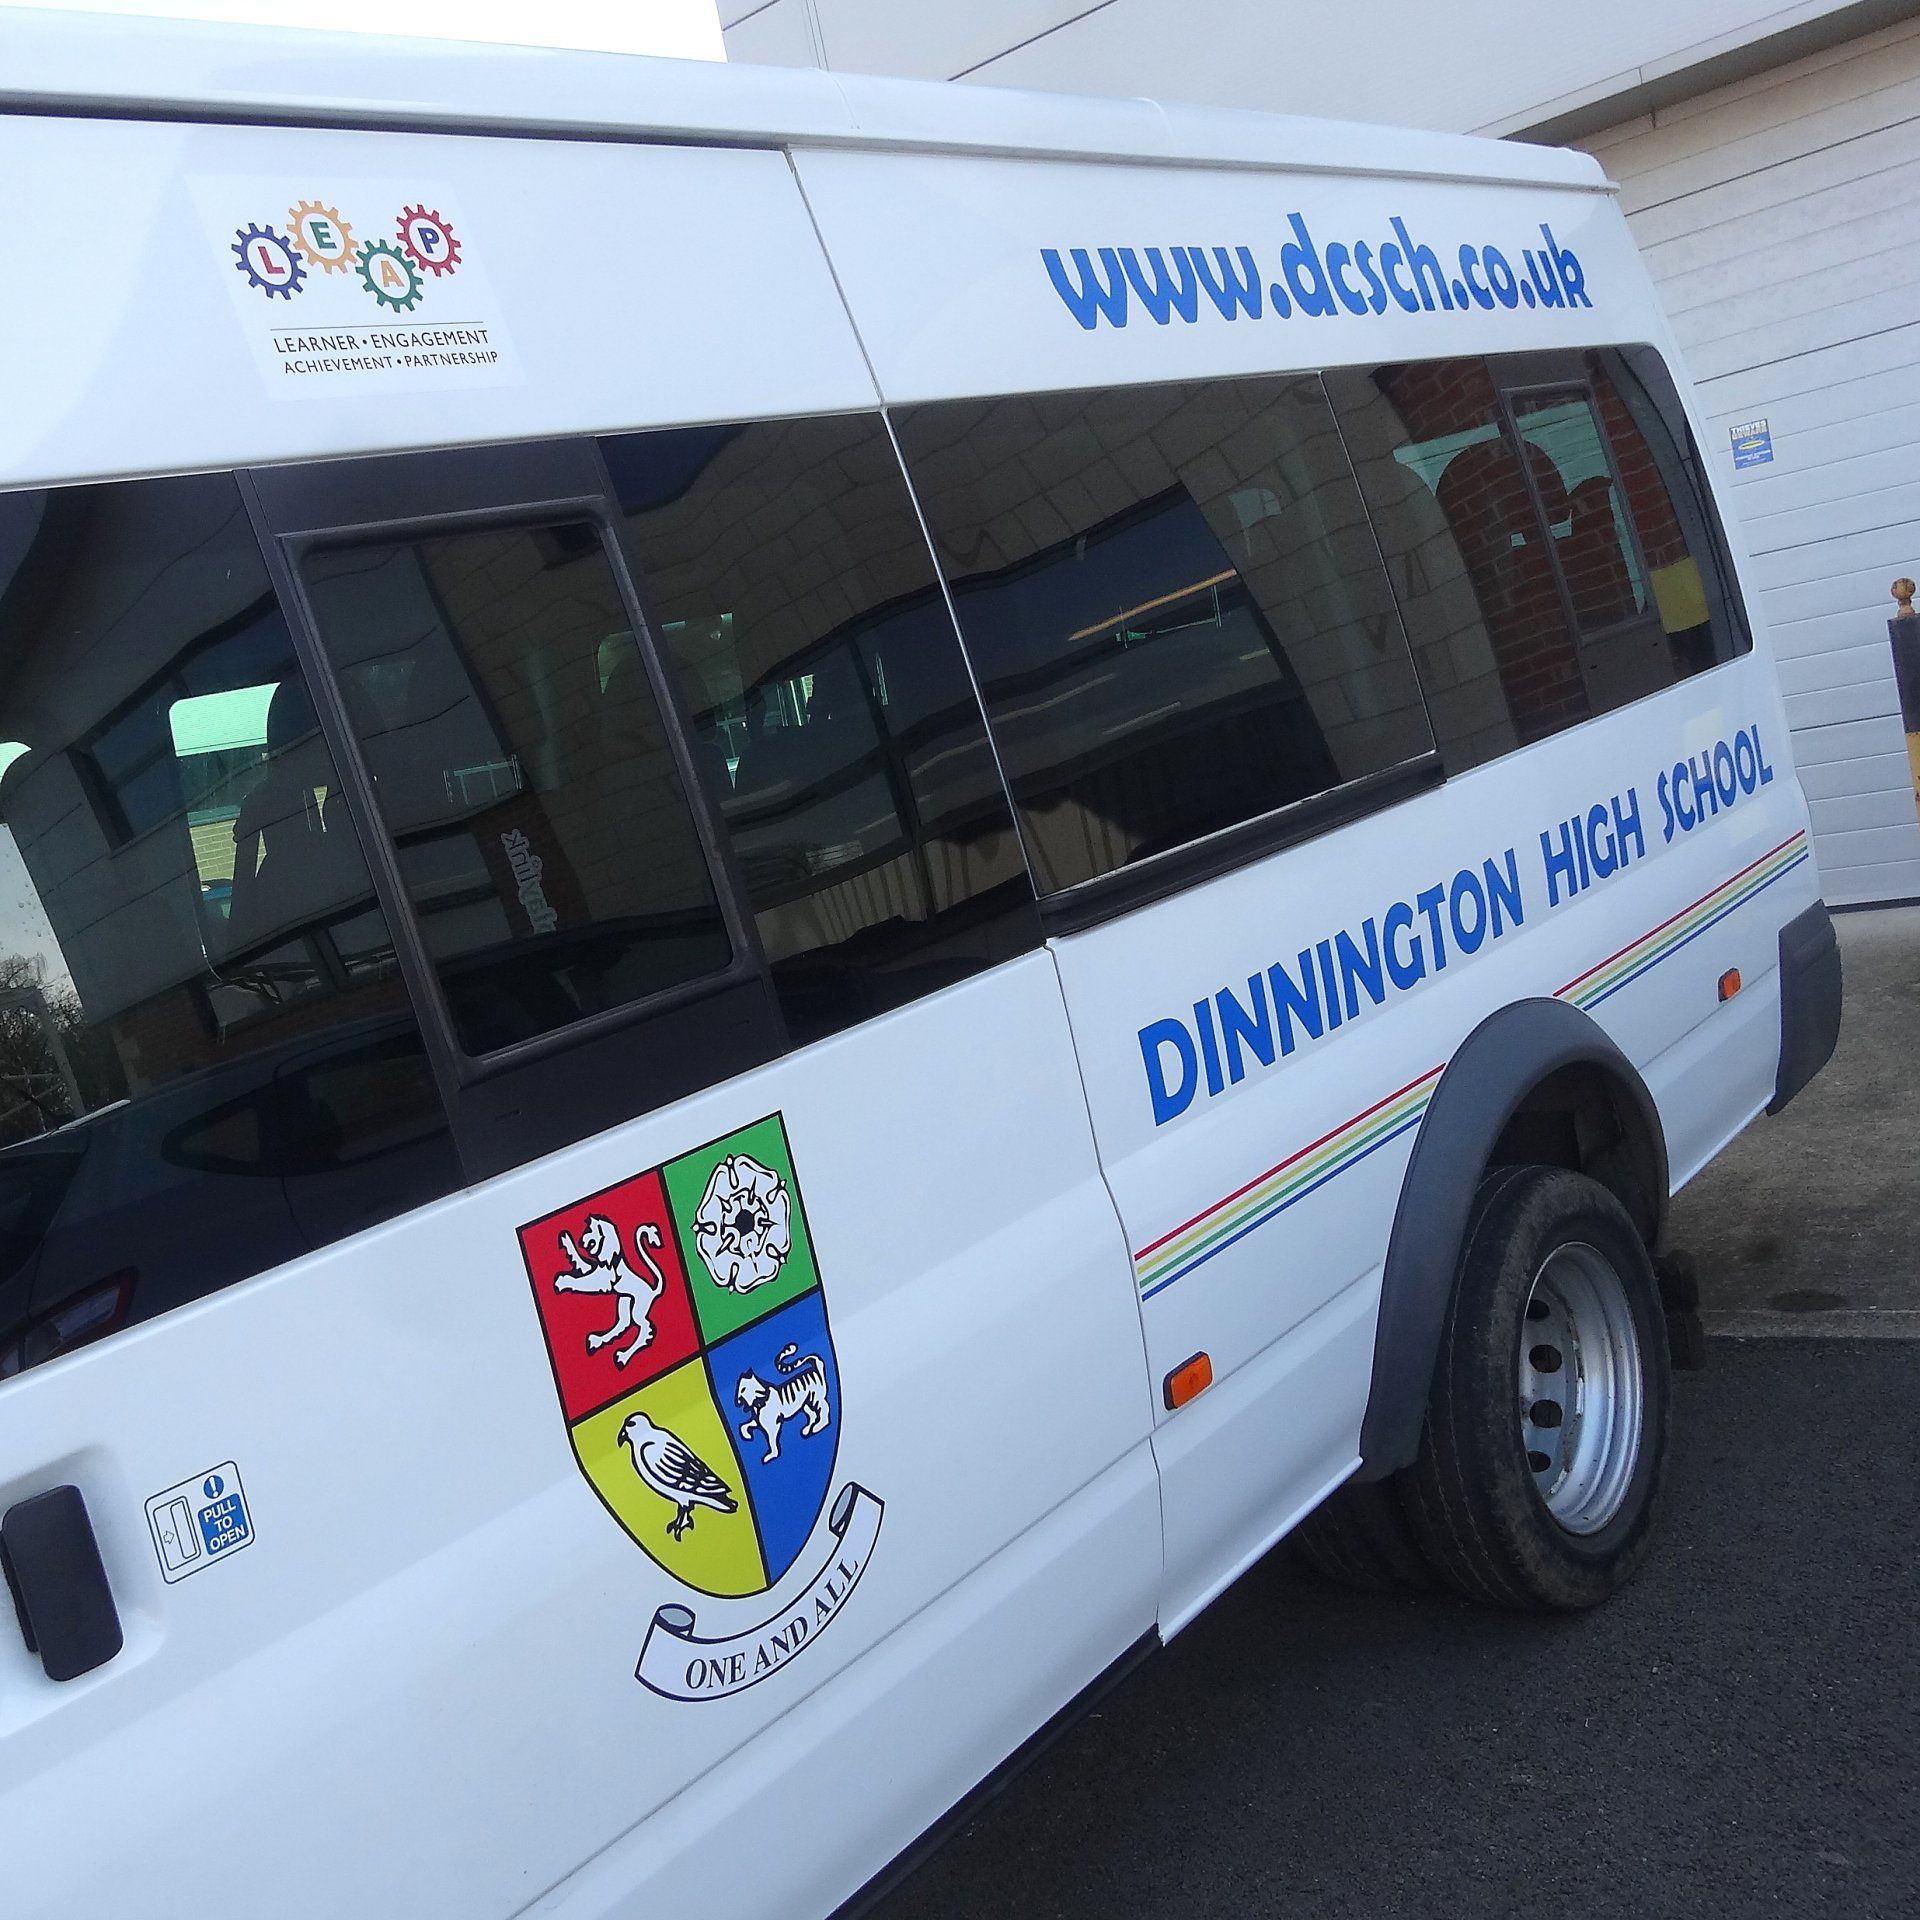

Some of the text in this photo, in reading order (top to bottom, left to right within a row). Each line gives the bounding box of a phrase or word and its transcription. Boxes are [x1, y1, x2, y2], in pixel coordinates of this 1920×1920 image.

[1040, 212, 1594, 331] www.dcsch.co.uk
[274, 329, 490, 353] LEARNER ENGAGEMENT
[285, 350, 498, 374] ACHIEVEMENT PARTNERSHIP
[1137, 723, 1774, 1127] DINNINGTON HIGH SCHOOL
[204, 1500, 237, 1522] PULL
[214, 1515, 233, 1532] TO
[210, 1525, 245, 1550] OPEN
[685, 1558, 860, 1690] ONE AND ALL
